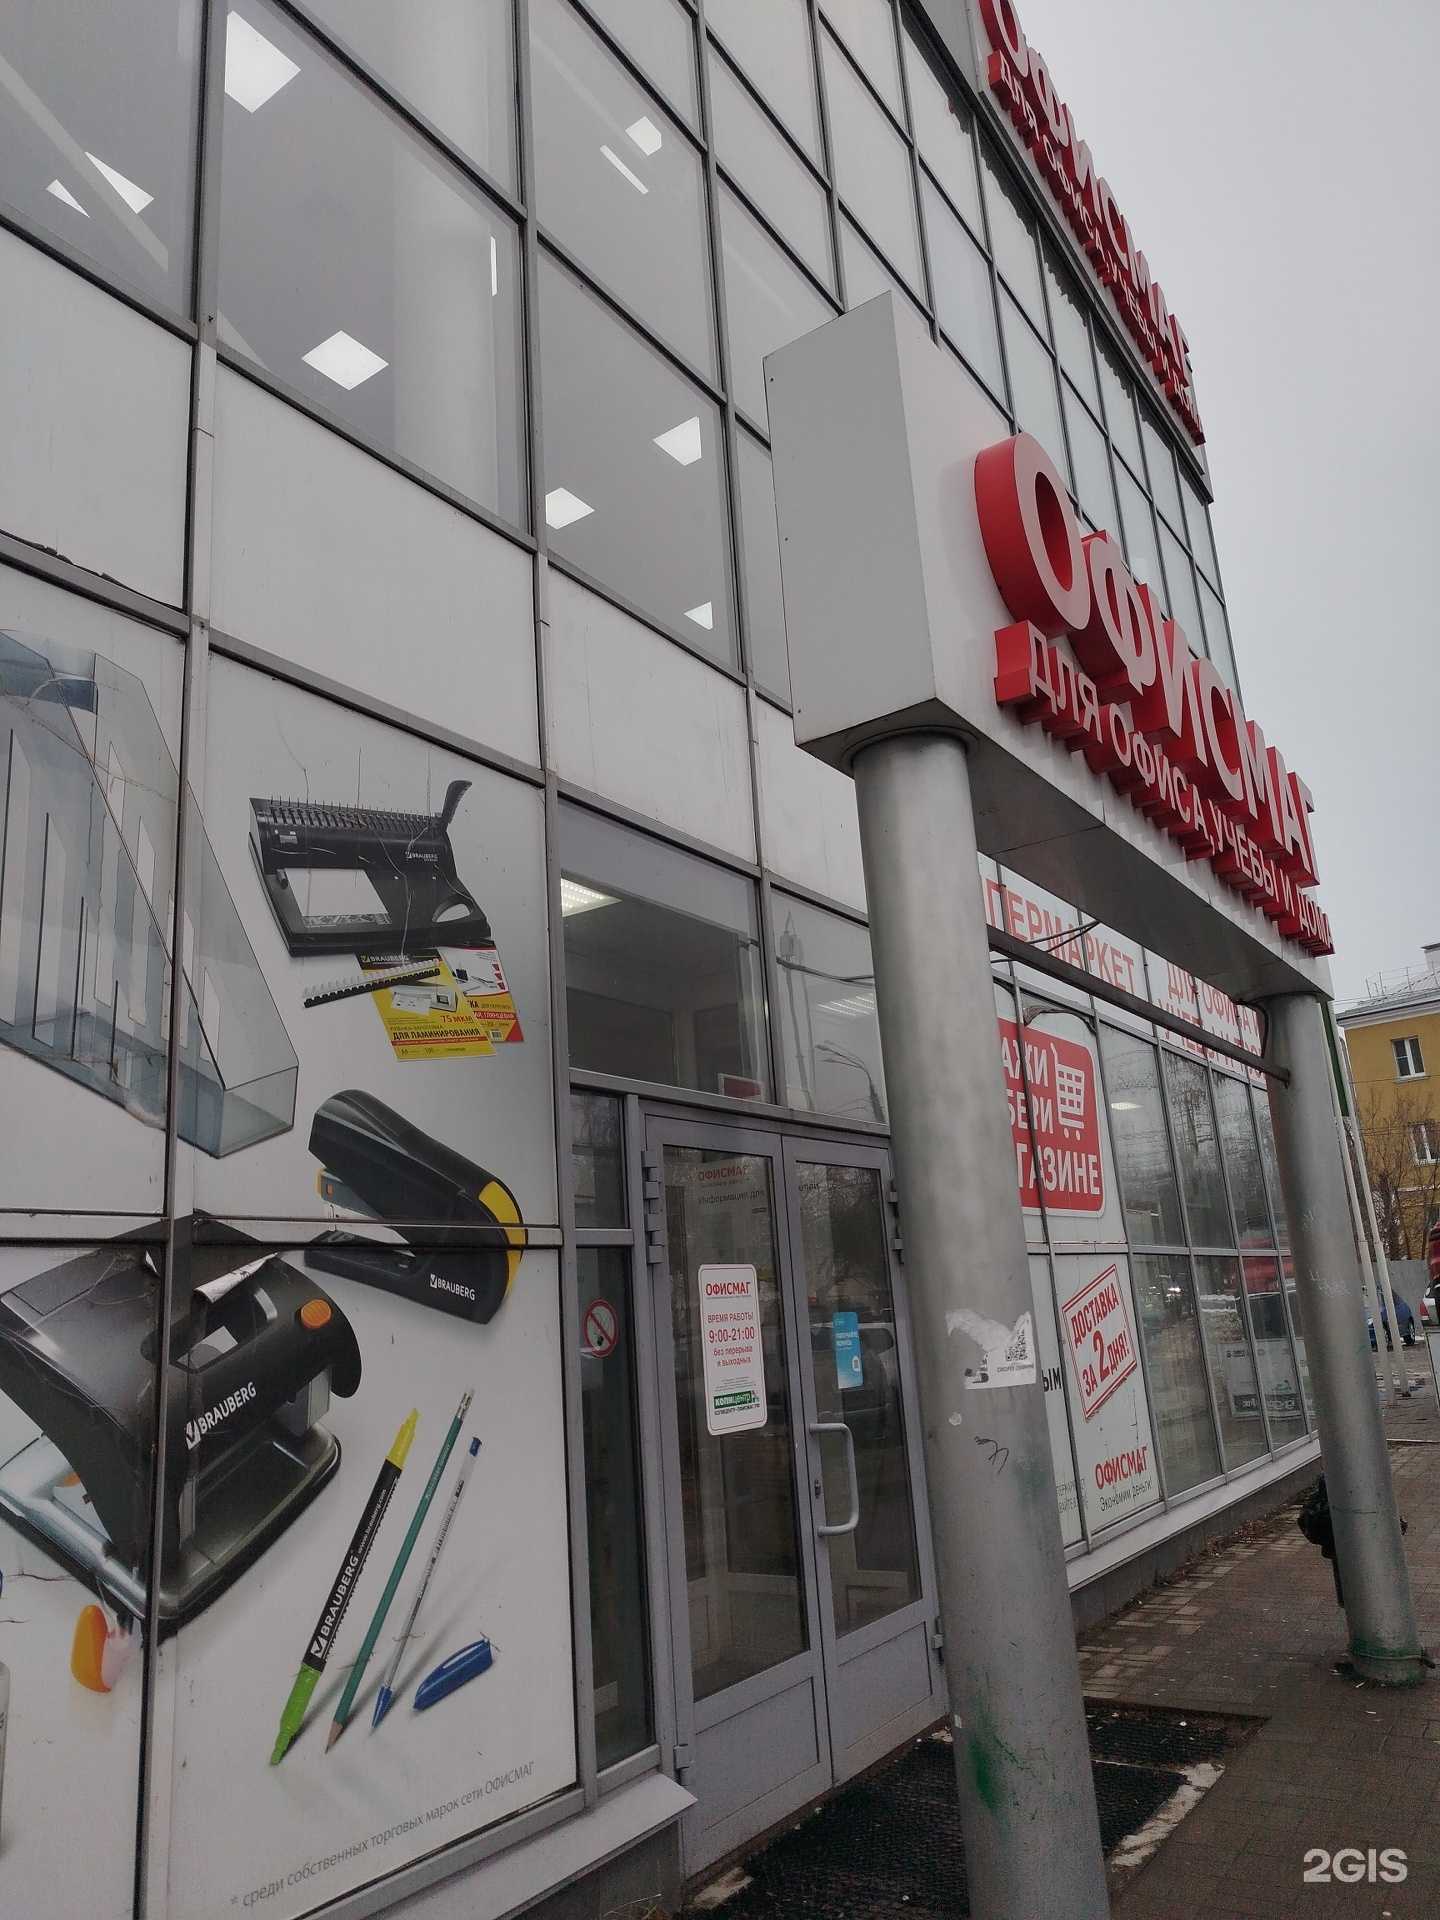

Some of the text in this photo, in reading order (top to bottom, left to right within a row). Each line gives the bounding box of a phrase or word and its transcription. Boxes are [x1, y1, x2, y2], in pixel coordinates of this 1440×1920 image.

[998, 49, 1040, 142] ДЛЯ
[975, 432, 1322, 885] ОФИСМАГ
[1026, 619, 1103, 744] ДЛЯ
[1279, 868, 1296, 917] И
[985, 878, 1134, 994] ПЕРМАРКЕТ
[393, 1031, 410, 1041] ДЛЯ
[411, 1027, 481, 1039] ЛАМИНИРОВАНИЯ
[1001, 1037, 1049, 1087] АЖИ
[1006, 1089, 1054, 1134] БЕРИ
[1016, 1142, 1101, 1195] ГАЗИНЕ
[437, 1276, 476, 1301] BRAUBERG
[705, 1281, 751, 1296] ОФИСМАГ
[707, 1311, 753, 1323] ВРЕМЯ РАБОТЫ
[708, 1326, 755, 1343] 9:00-21:00
[1071, 1282, 1119, 1349] ДОСТАВКА
[1041, 1367, 1062, 1392] ЫМ
[1083, 1330, 1130, 1398] ЗА 2 ДНЯ!
[199, 1381, 257, 1435] BRAUBERG
[1095, 1446, 1148, 1490] ОФИСМАГ
[320, 1554, 359, 1637] BRAUBERG
[242, 1761, 536, 1908] среди собственных торговых марок сети ОФИСМАГ
